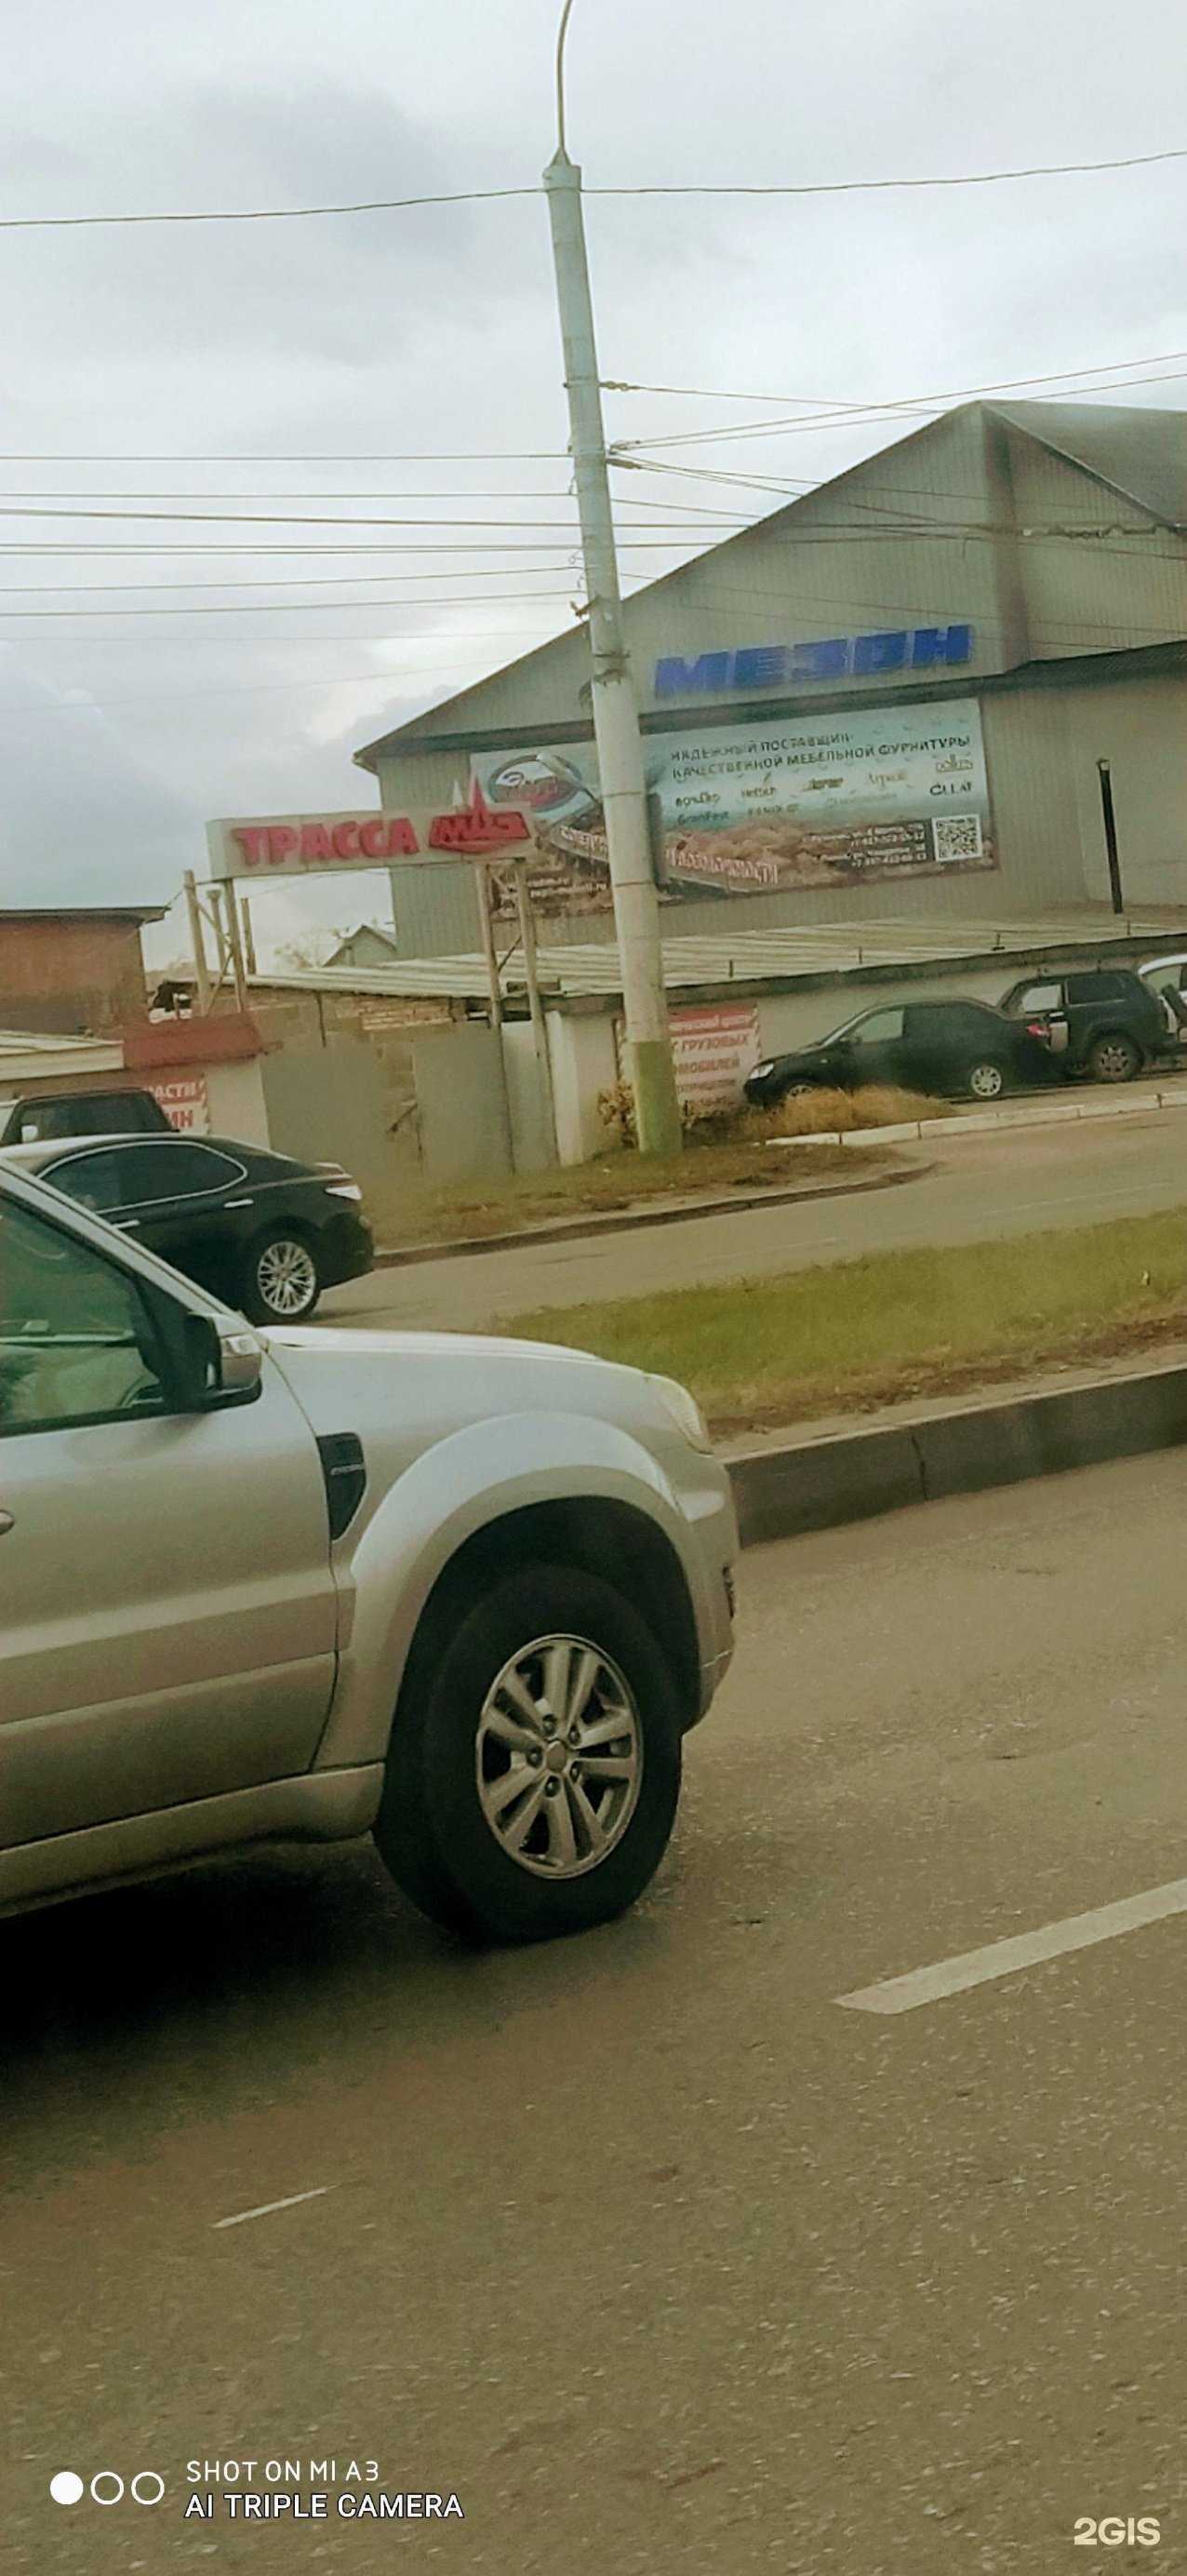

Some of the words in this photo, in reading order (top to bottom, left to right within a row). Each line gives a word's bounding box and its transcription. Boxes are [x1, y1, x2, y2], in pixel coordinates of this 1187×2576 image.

[655, 624, 972, 699] МЕЗОН
[672, 755, 783, 780] КАЧЕСТВЕННОЙ
[787, 746, 875, 767] МЕБЕЛЬНОЙ
[878, 735, 971, 756] ФУРНИТУРЫ
[232, 817, 420, 866] ТРАССА
[676, 1053, 740, 1073] МОБИЛЕЙ
